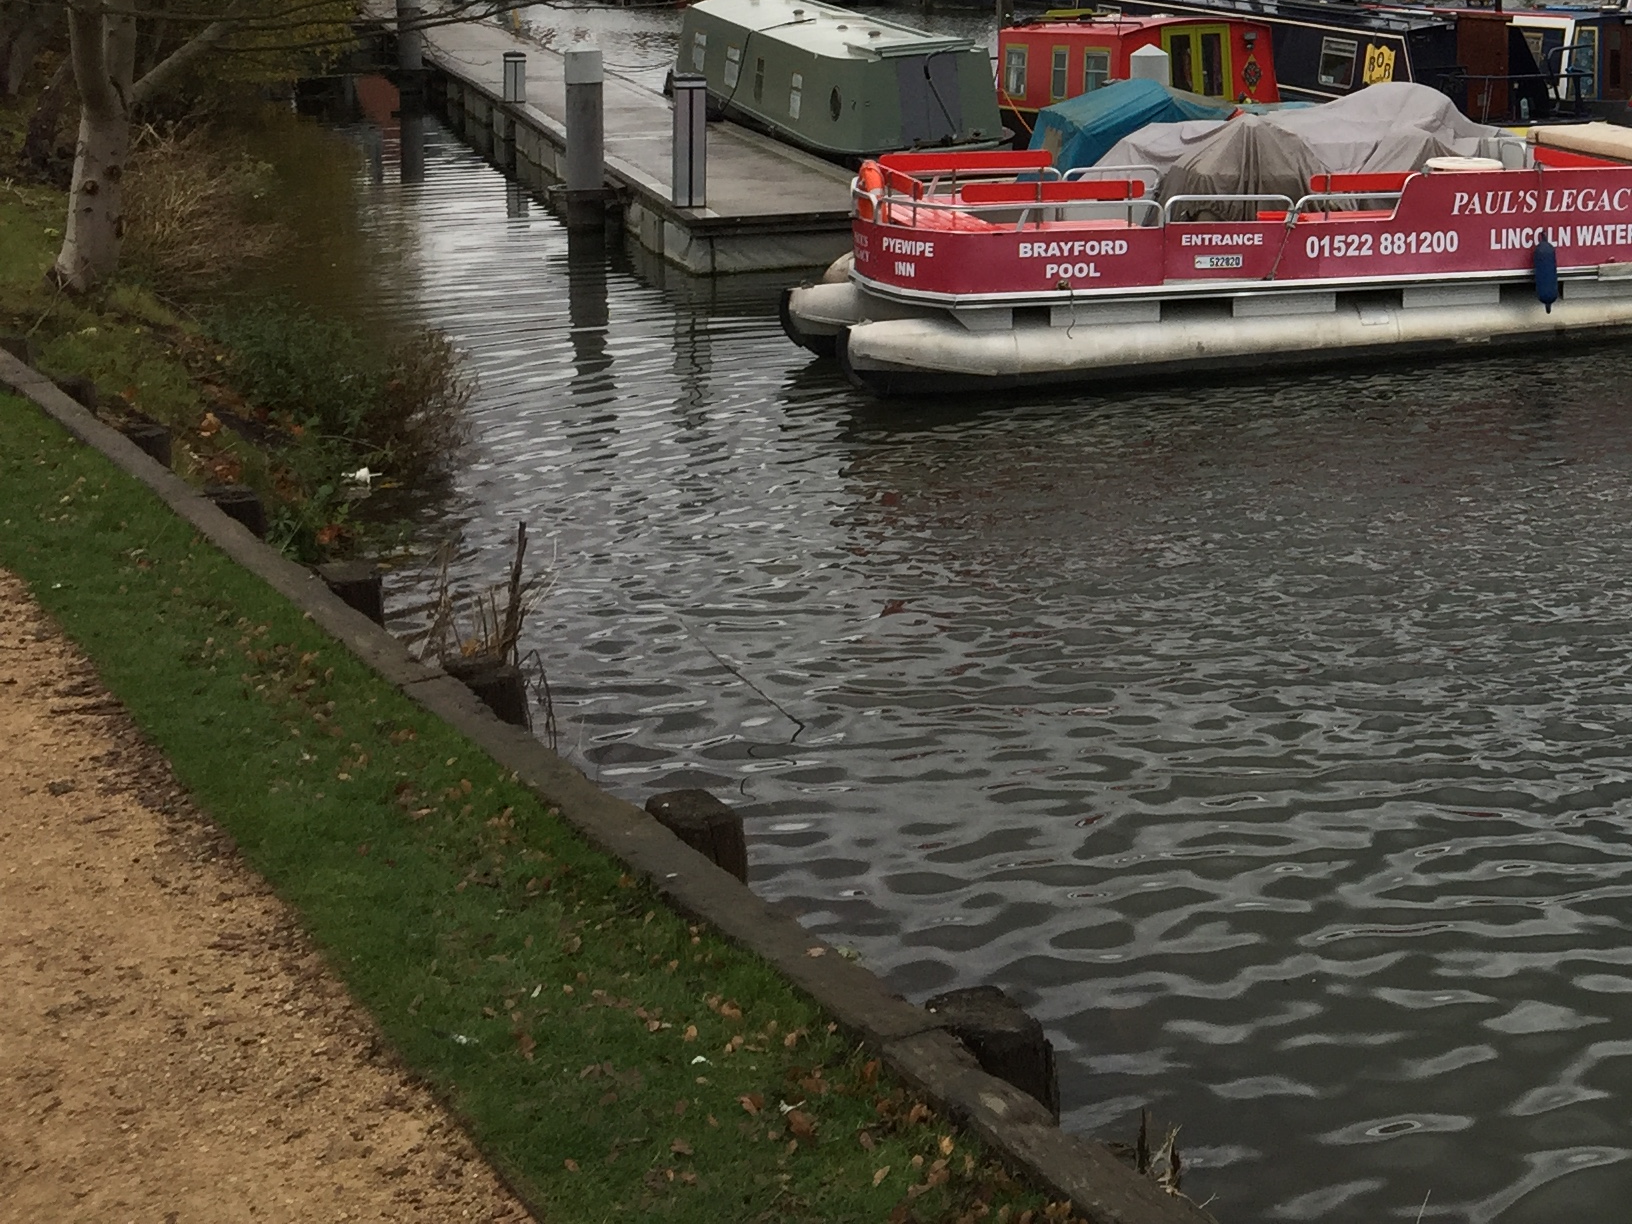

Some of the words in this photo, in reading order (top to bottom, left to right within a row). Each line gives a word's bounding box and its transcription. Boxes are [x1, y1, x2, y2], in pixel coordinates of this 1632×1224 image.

[1451, 189, 1539, 216] PAUL'S
[882, 236, 935, 258] PYEWIPE
[1018, 240, 1129, 258] BRAYFORD
[1181, 233, 1264, 247] ENTRANCE
[1305, 233, 1374, 259] 01522
[1378, 230, 1459, 256] 881200
[894, 261, 916, 278] INN
[1045, 262, 1101, 279] POOL
